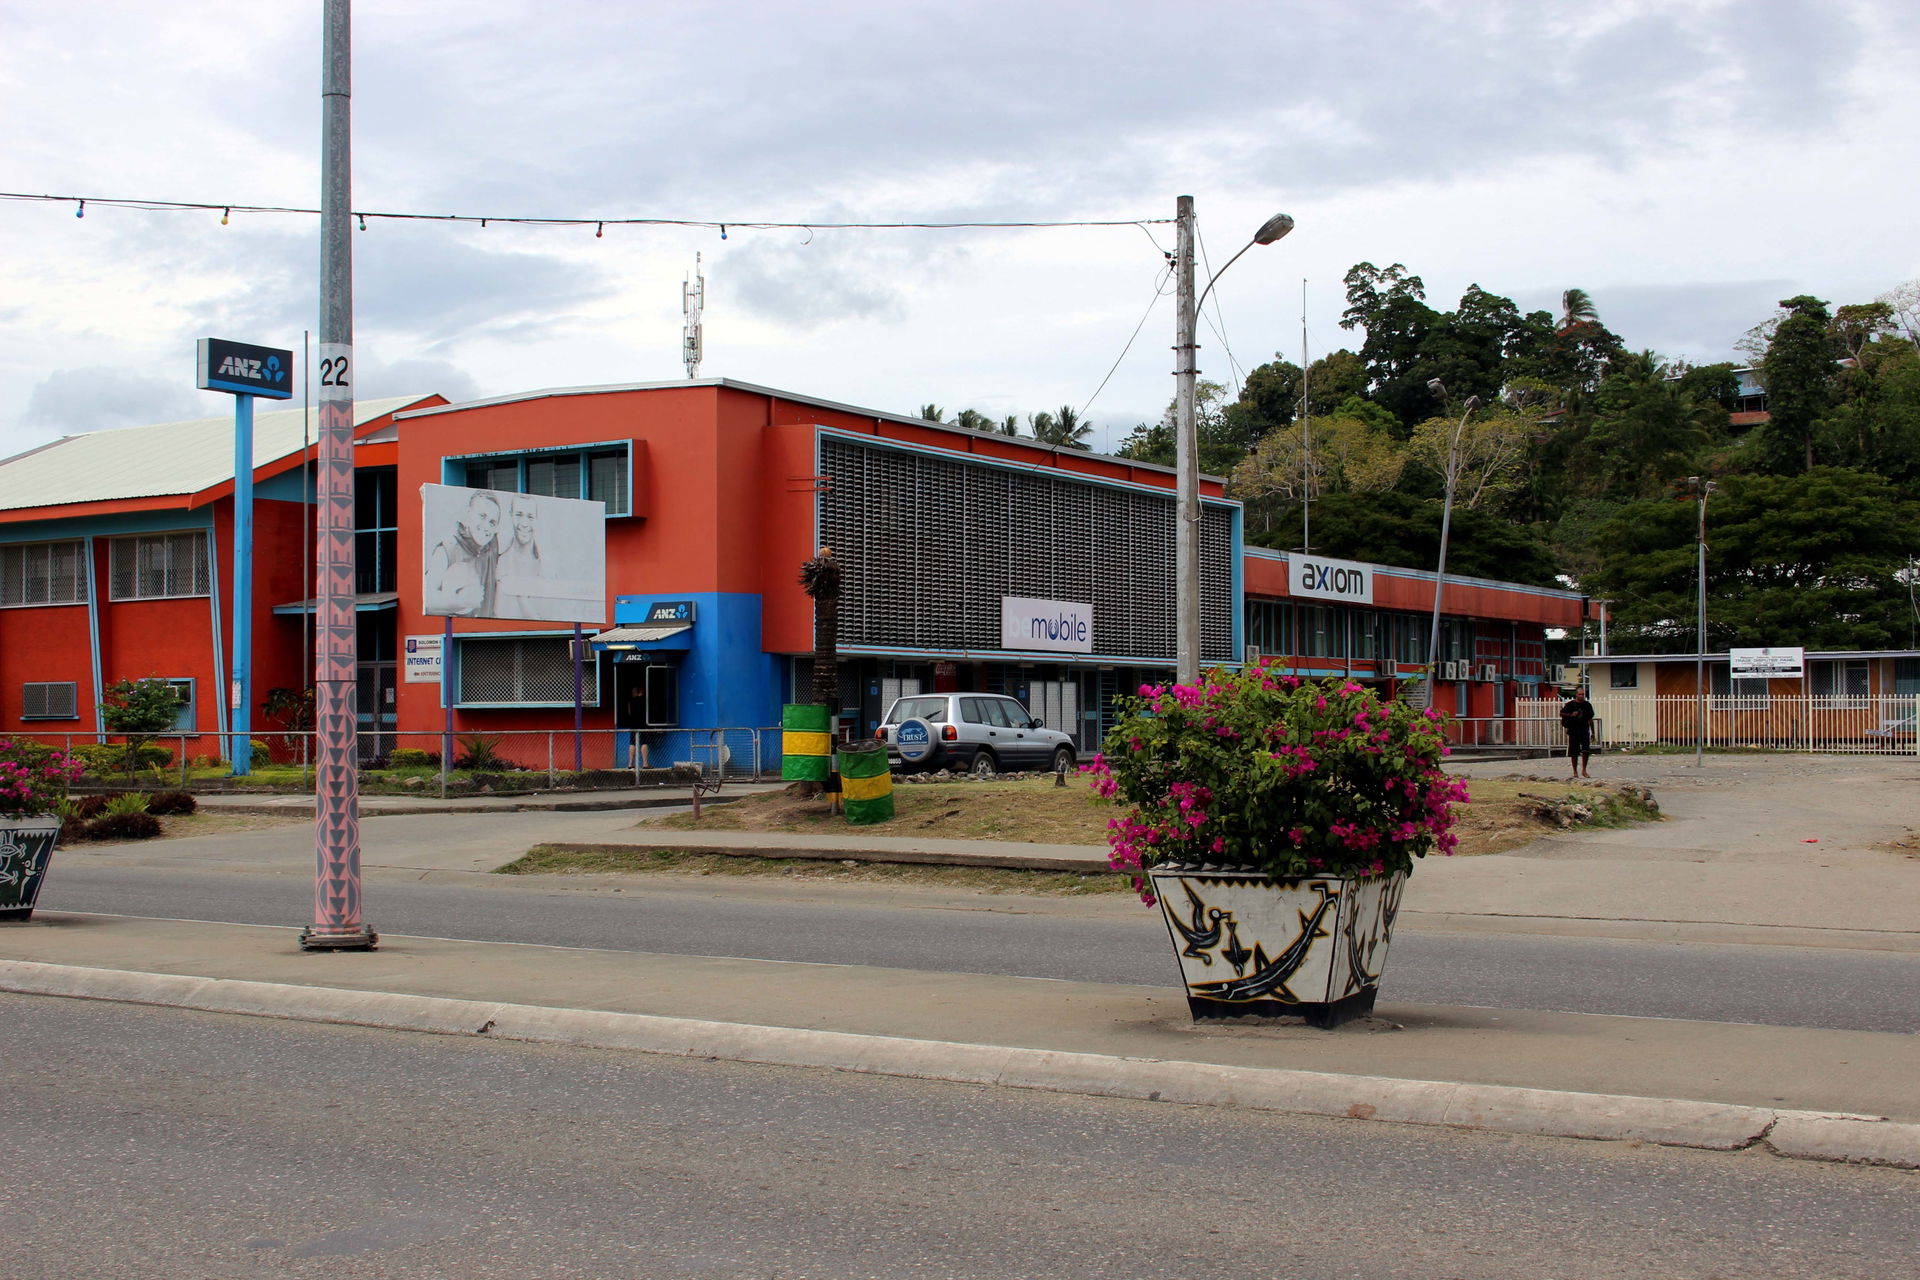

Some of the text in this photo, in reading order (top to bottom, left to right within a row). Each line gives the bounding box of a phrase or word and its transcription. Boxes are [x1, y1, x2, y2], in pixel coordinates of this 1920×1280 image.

[218, 355, 262, 380] ANZ
[320, 355, 349, 387] 22
[1302, 563, 1364, 595] axiom
[653, 608, 676, 619] ANZ
[407, 657, 434, 666] INTERNET
[903, 733, 922, 742] TRUST
